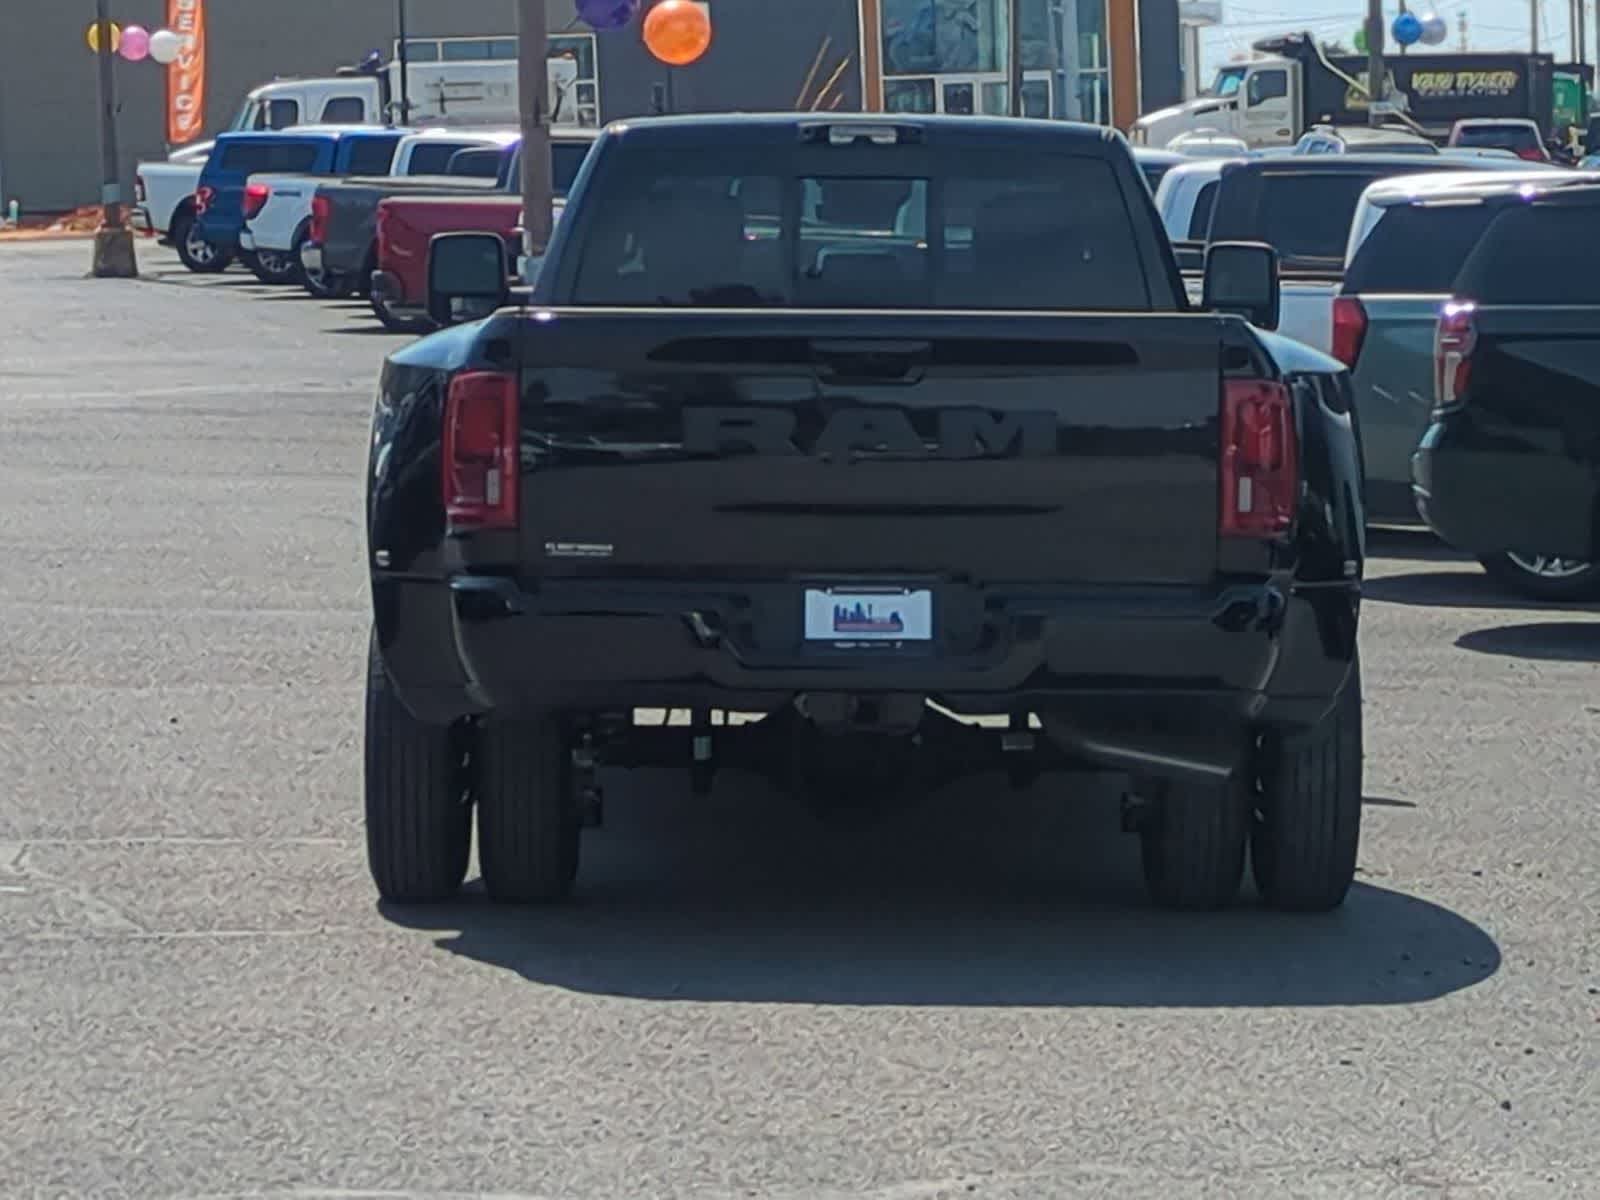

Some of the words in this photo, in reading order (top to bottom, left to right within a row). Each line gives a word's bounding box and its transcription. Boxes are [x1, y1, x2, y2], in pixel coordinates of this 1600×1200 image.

[1411, 71, 1454, 90] VAN
[1455, 71, 1518, 90] TYLER
[681, 405, 1057, 458] RAM
